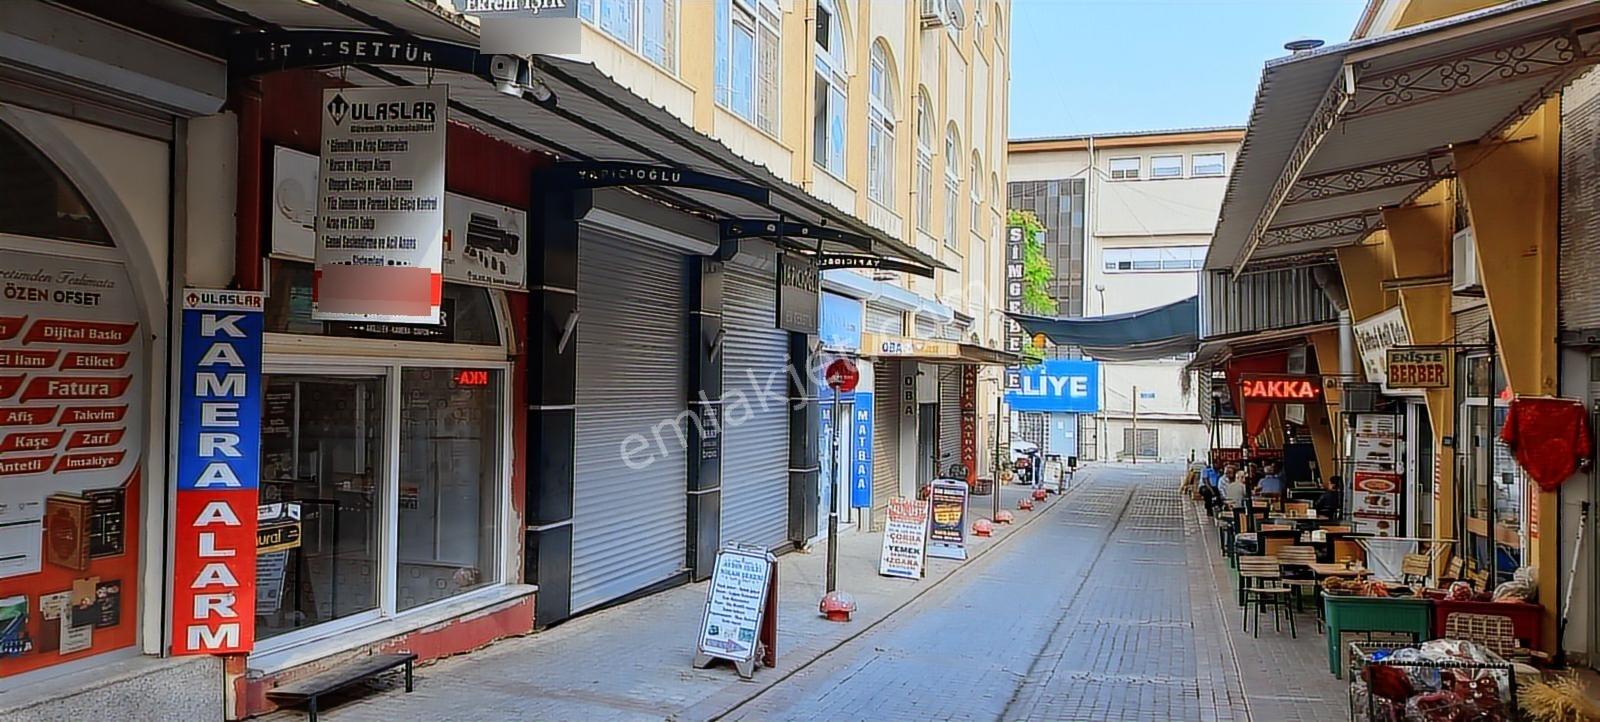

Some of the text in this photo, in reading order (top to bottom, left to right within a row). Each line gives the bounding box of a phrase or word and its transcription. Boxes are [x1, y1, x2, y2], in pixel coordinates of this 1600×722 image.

[351, 102, 435, 123] ULASLAR
[4, 282, 101, 306] ÖZEN OFSET
[201, 293, 262, 308] ULASLAR
[44, 326, 122, 340] Dijital Baskı
[76, 355, 114, 367] Etiket
[1391, 351, 1443, 363] ENİŞTE
[1390, 364, 1445, 385] BERBER
[48, 381, 109, 396] Fatura
[6, 412, 33, 425] Afiş
[73, 410, 115, 421] Takvim
[15, 436, 49, 450] Kaşe
[82, 433, 111, 445] Zarf
[856, 409, 869, 490] MATBAA
[187, 313, 248, 650] KAMERA ALARM
